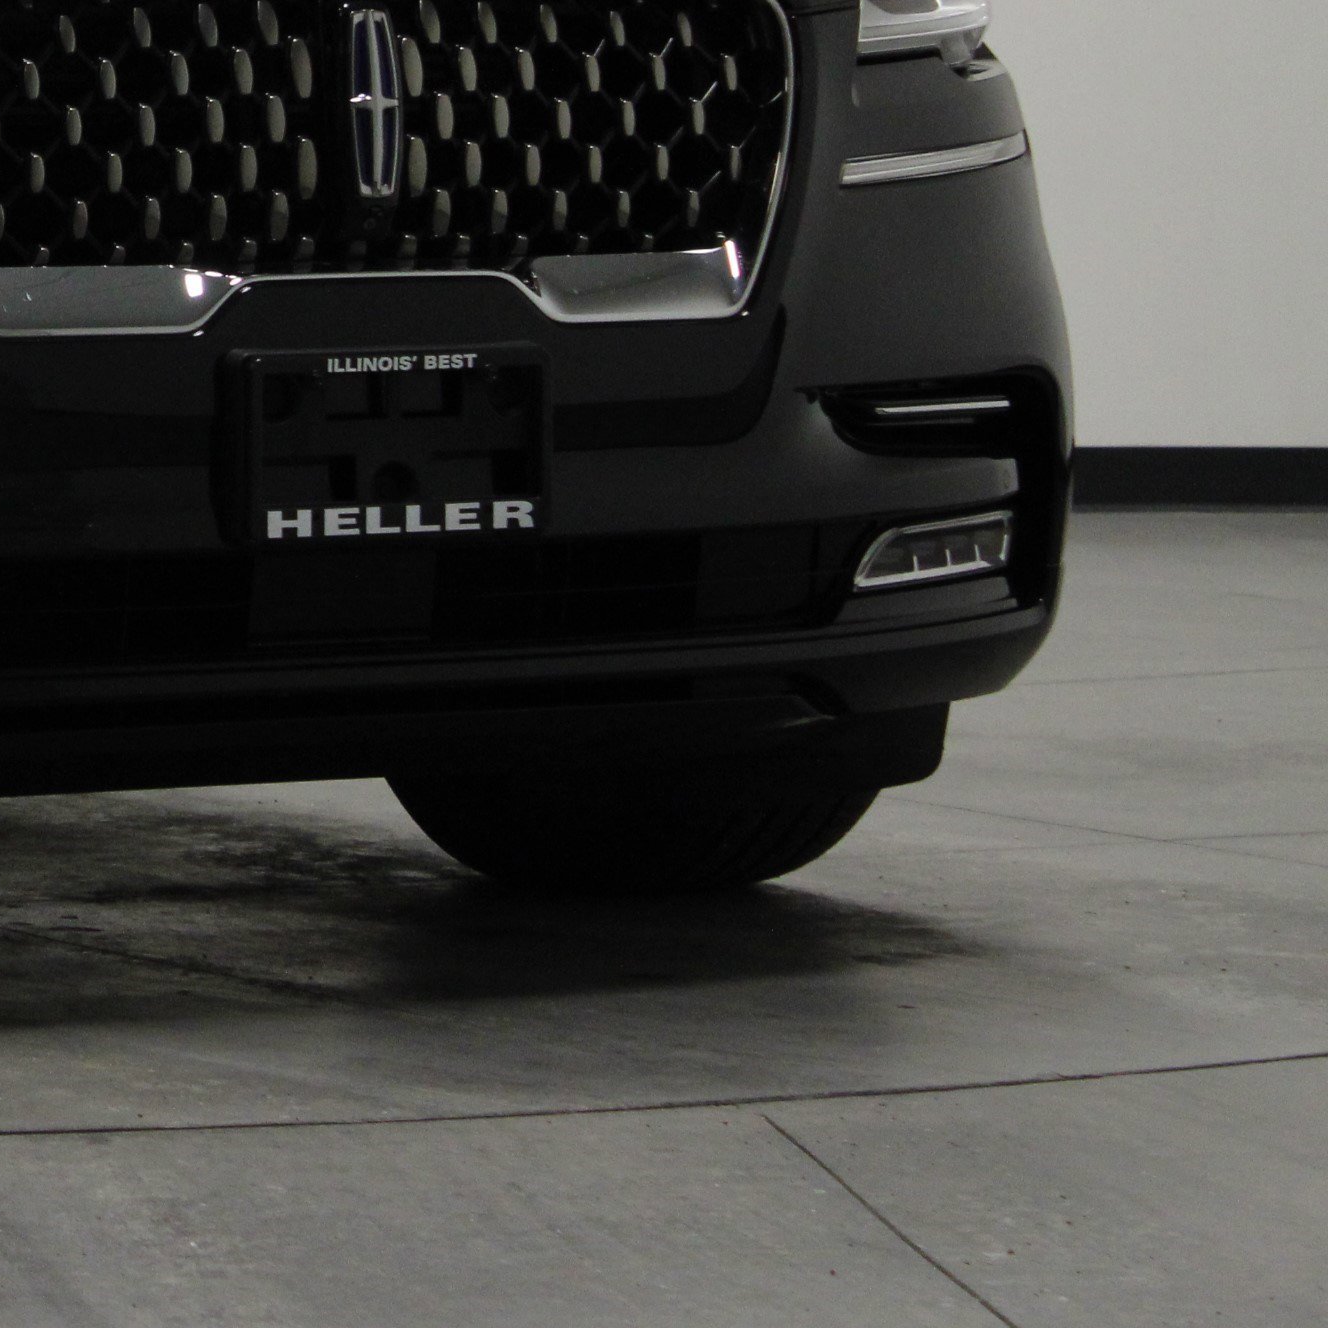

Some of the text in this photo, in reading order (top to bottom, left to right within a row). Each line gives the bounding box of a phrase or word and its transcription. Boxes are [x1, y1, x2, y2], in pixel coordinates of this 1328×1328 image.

[327, 353, 478, 373] ILLINOIS' BEST
[266, 500, 535, 539] HELLER
